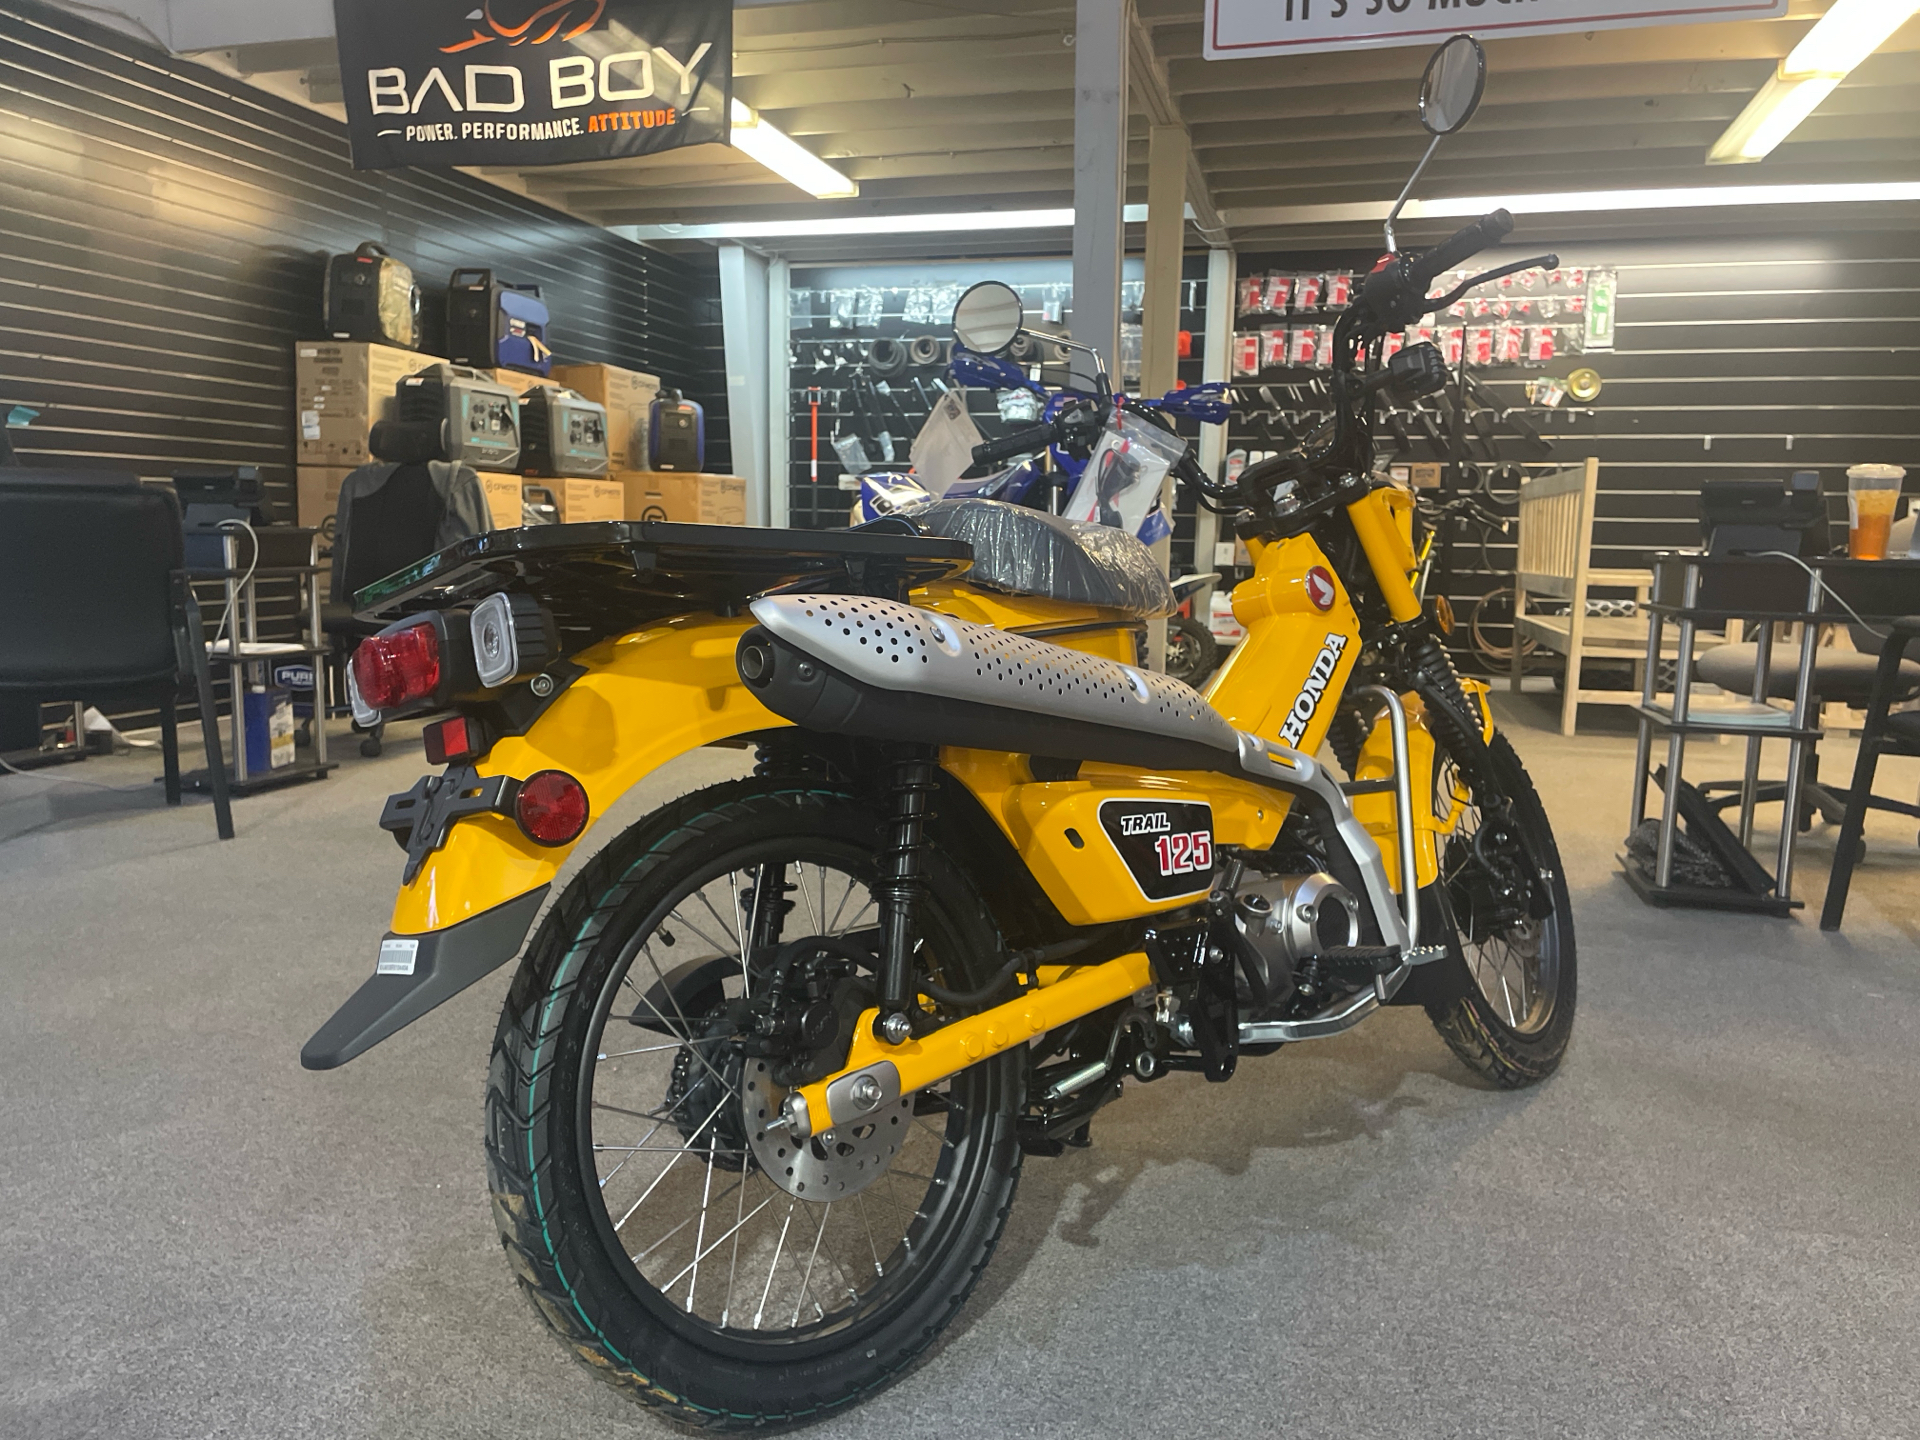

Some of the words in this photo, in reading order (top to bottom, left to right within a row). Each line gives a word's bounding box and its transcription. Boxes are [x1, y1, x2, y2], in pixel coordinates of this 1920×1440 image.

[368, 64, 524, 116] BAD
[549, 42, 712, 110] BOY
[405, 122, 458, 142] POWER.
[461, 117, 584, 140] PERFORMANCE.
[1279, 632, 1348, 749] HONDA
[1121, 812, 1171, 836] TRAIL
[1155, 830, 1213, 877] 125
